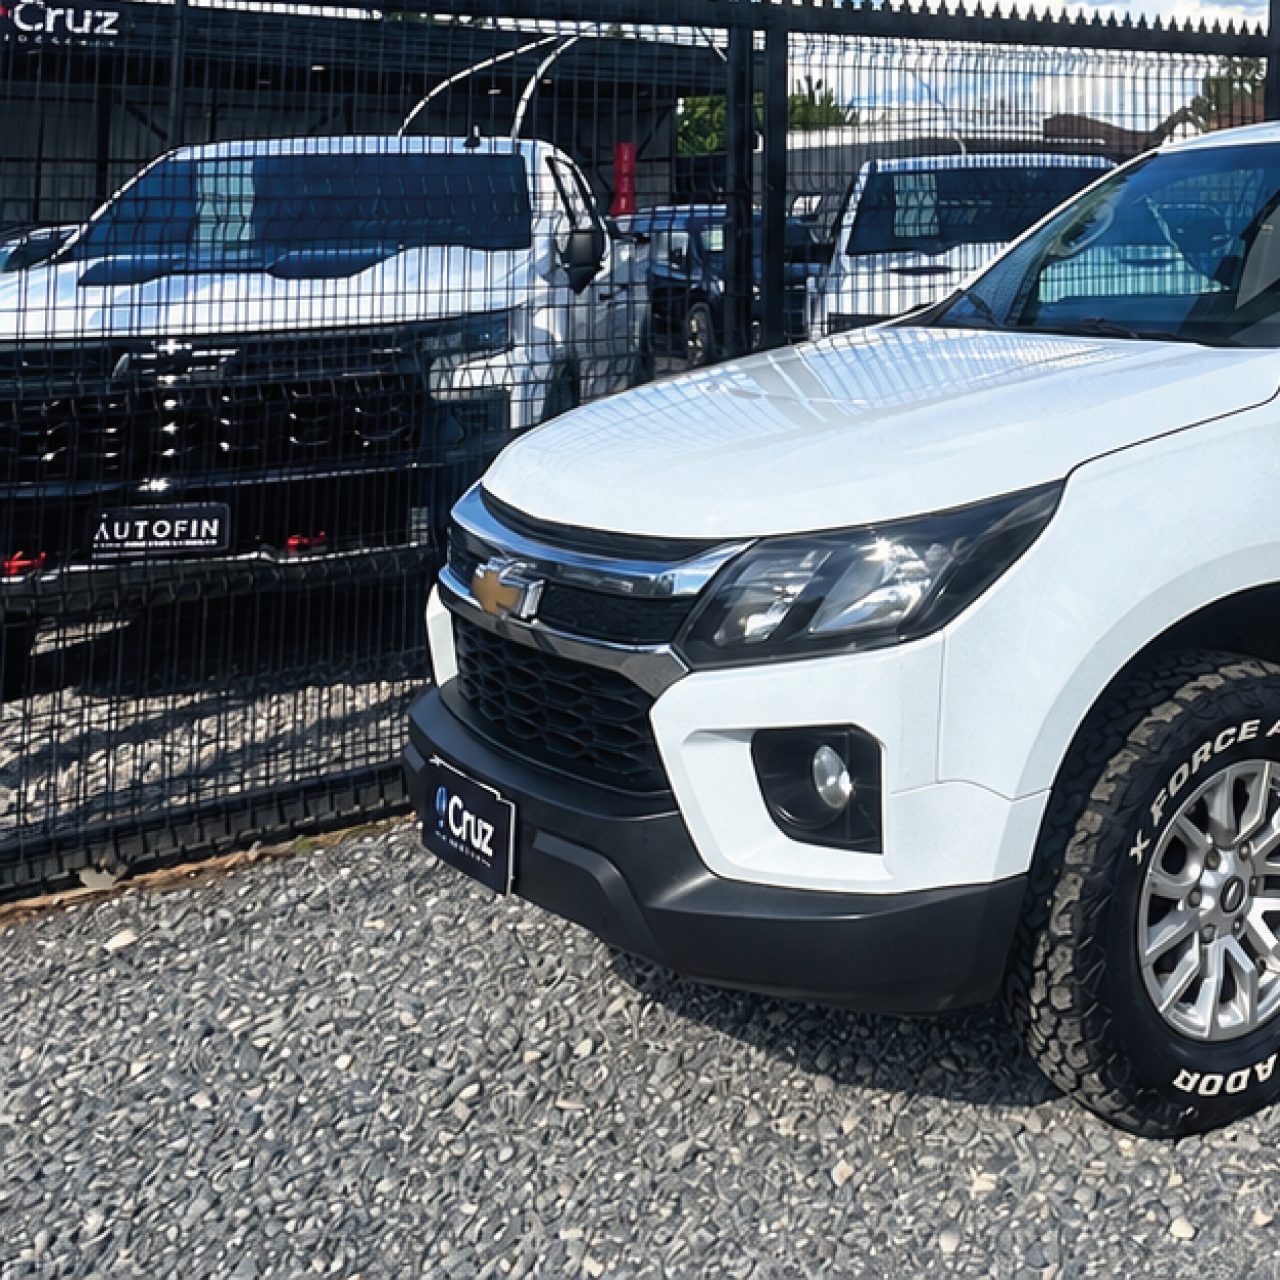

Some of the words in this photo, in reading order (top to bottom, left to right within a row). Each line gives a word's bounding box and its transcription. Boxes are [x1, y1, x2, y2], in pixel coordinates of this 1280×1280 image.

[93, 514, 220, 541] AUTOFIN
[1129, 829, 1151, 864] X
[1150, 719, 1261, 827] FORCE
[448, 795, 495, 856] Cruz
